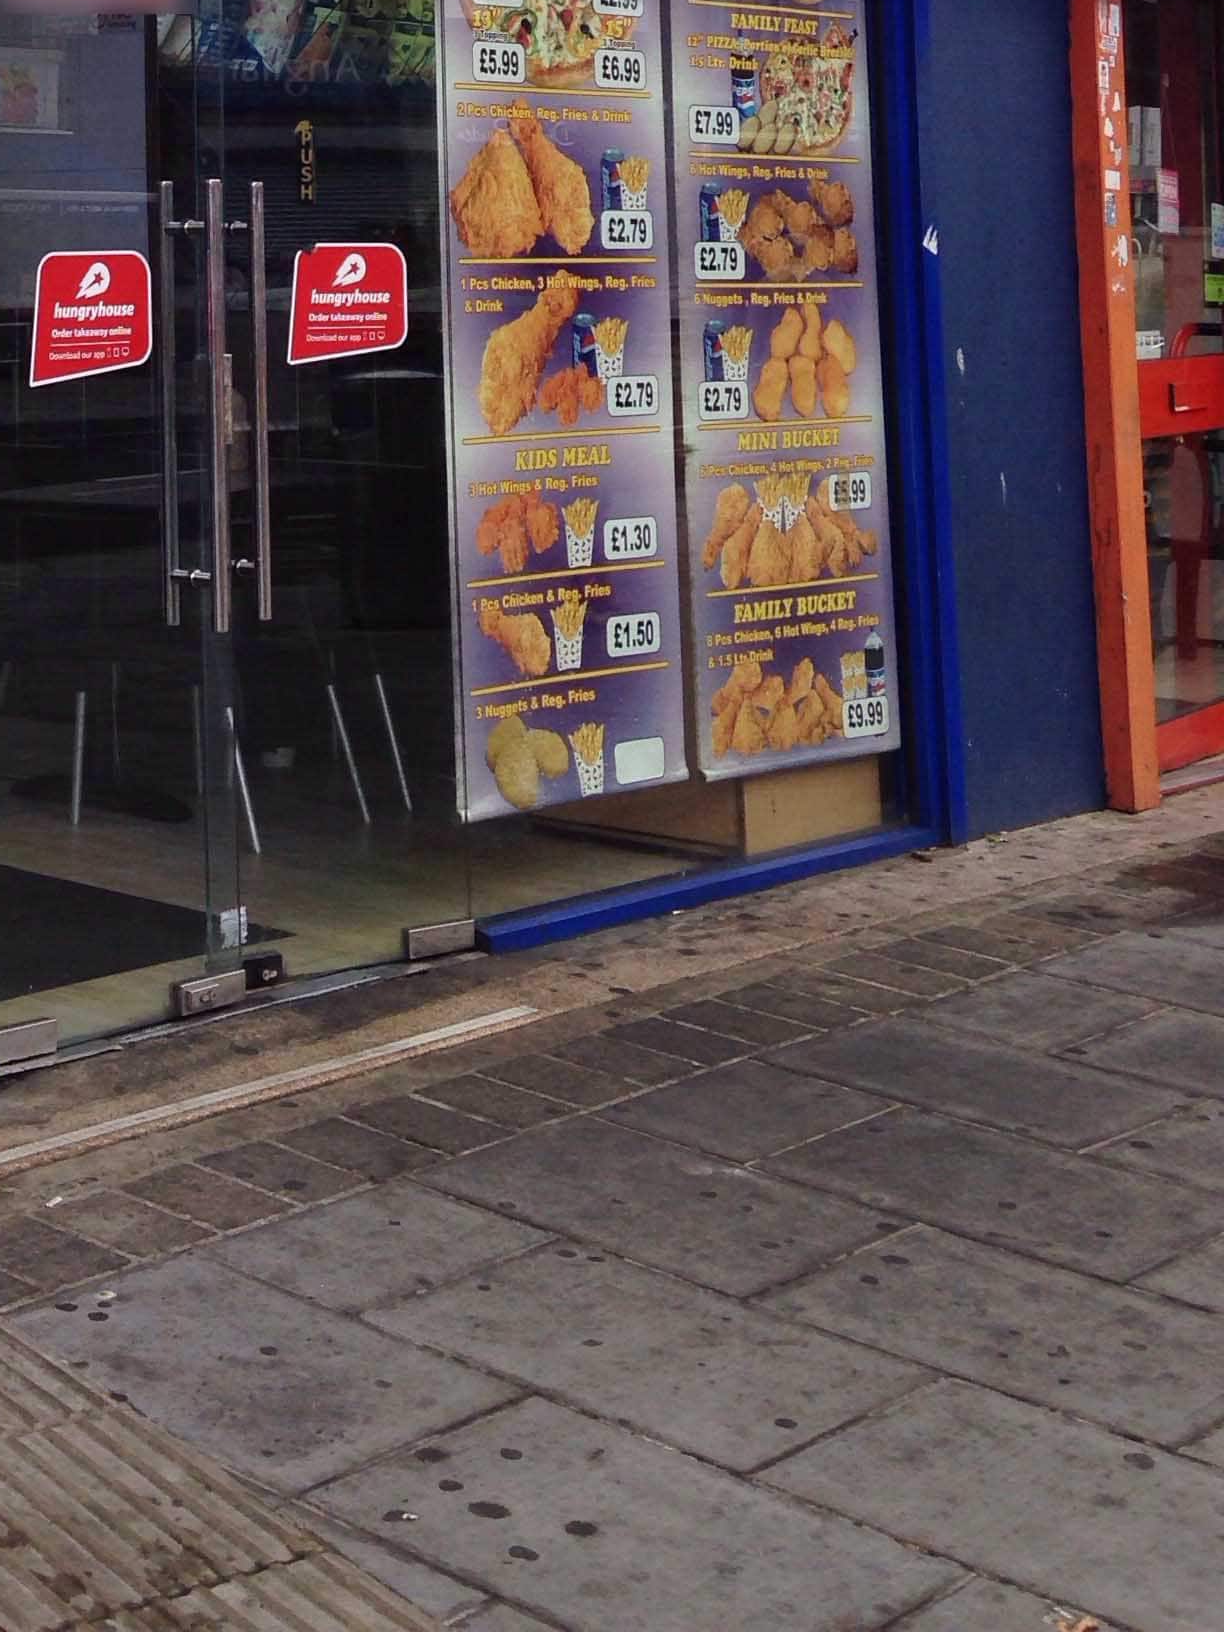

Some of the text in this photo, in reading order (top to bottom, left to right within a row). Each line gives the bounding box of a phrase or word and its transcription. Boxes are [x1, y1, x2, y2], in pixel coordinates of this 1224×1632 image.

[731, 13, 818, 35] FAMILY FEAST
[479, 48, 519, 76] £5.99
[602, 55, 641, 83] £6.99
[729, 56, 759, 71] Drink
[457, 103, 464, 117] 2
[467, 103, 487, 117] Pcs
[489, 104, 534, 119] Chicken,
[536, 107, 560, 123] Reg.
[563, 108, 587, 121] Fries
[591, 110, 599, 121] &
[694, 109, 733, 137] £7.99
[301, 130, 312, 200] PUSH
[608, 217, 647, 244] £2.79
[700, 247, 738, 271] £2.79
[461, 275, 656, 292] 1 Pcs Chicken, 3 Hot Wings, Reg. Fries
[311, 288, 390, 307] hungryhouse
[464, 299, 503, 313] & Drink
[703, 293, 743, 307] Nuggets
[54, 301, 135, 322] hungryhouse
[614, 381, 654, 409] £2.79
[704, 386, 741, 412] £2.79
[738, 428, 841, 451] MINI BUCKET
[515, 445, 612, 471] KIDS MEAL
[479, 483, 497, 495] Hot
[500, 480, 531, 495] Wings
[534, 479, 543, 491] &
[545, 477, 568, 492] Reg.
[572, 474, 600, 487] Fries
[610, 524, 651, 553] £1.30
[480, 598, 499, 611] Pcs
[502, 592, 544, 609] Chicken
[546, 589, 555, 602] &
[558, 587, 582, 604] Reg.
[584, 584, 611, 598] Fries
[734, 590, 856, 624] FAMILY BUCKET
[613, 619, 655, 650] £1.50
[476, 689, 596, 720] 3 Nuggets & Reg. Fries
[847, 698, 885, 728] £9.99
